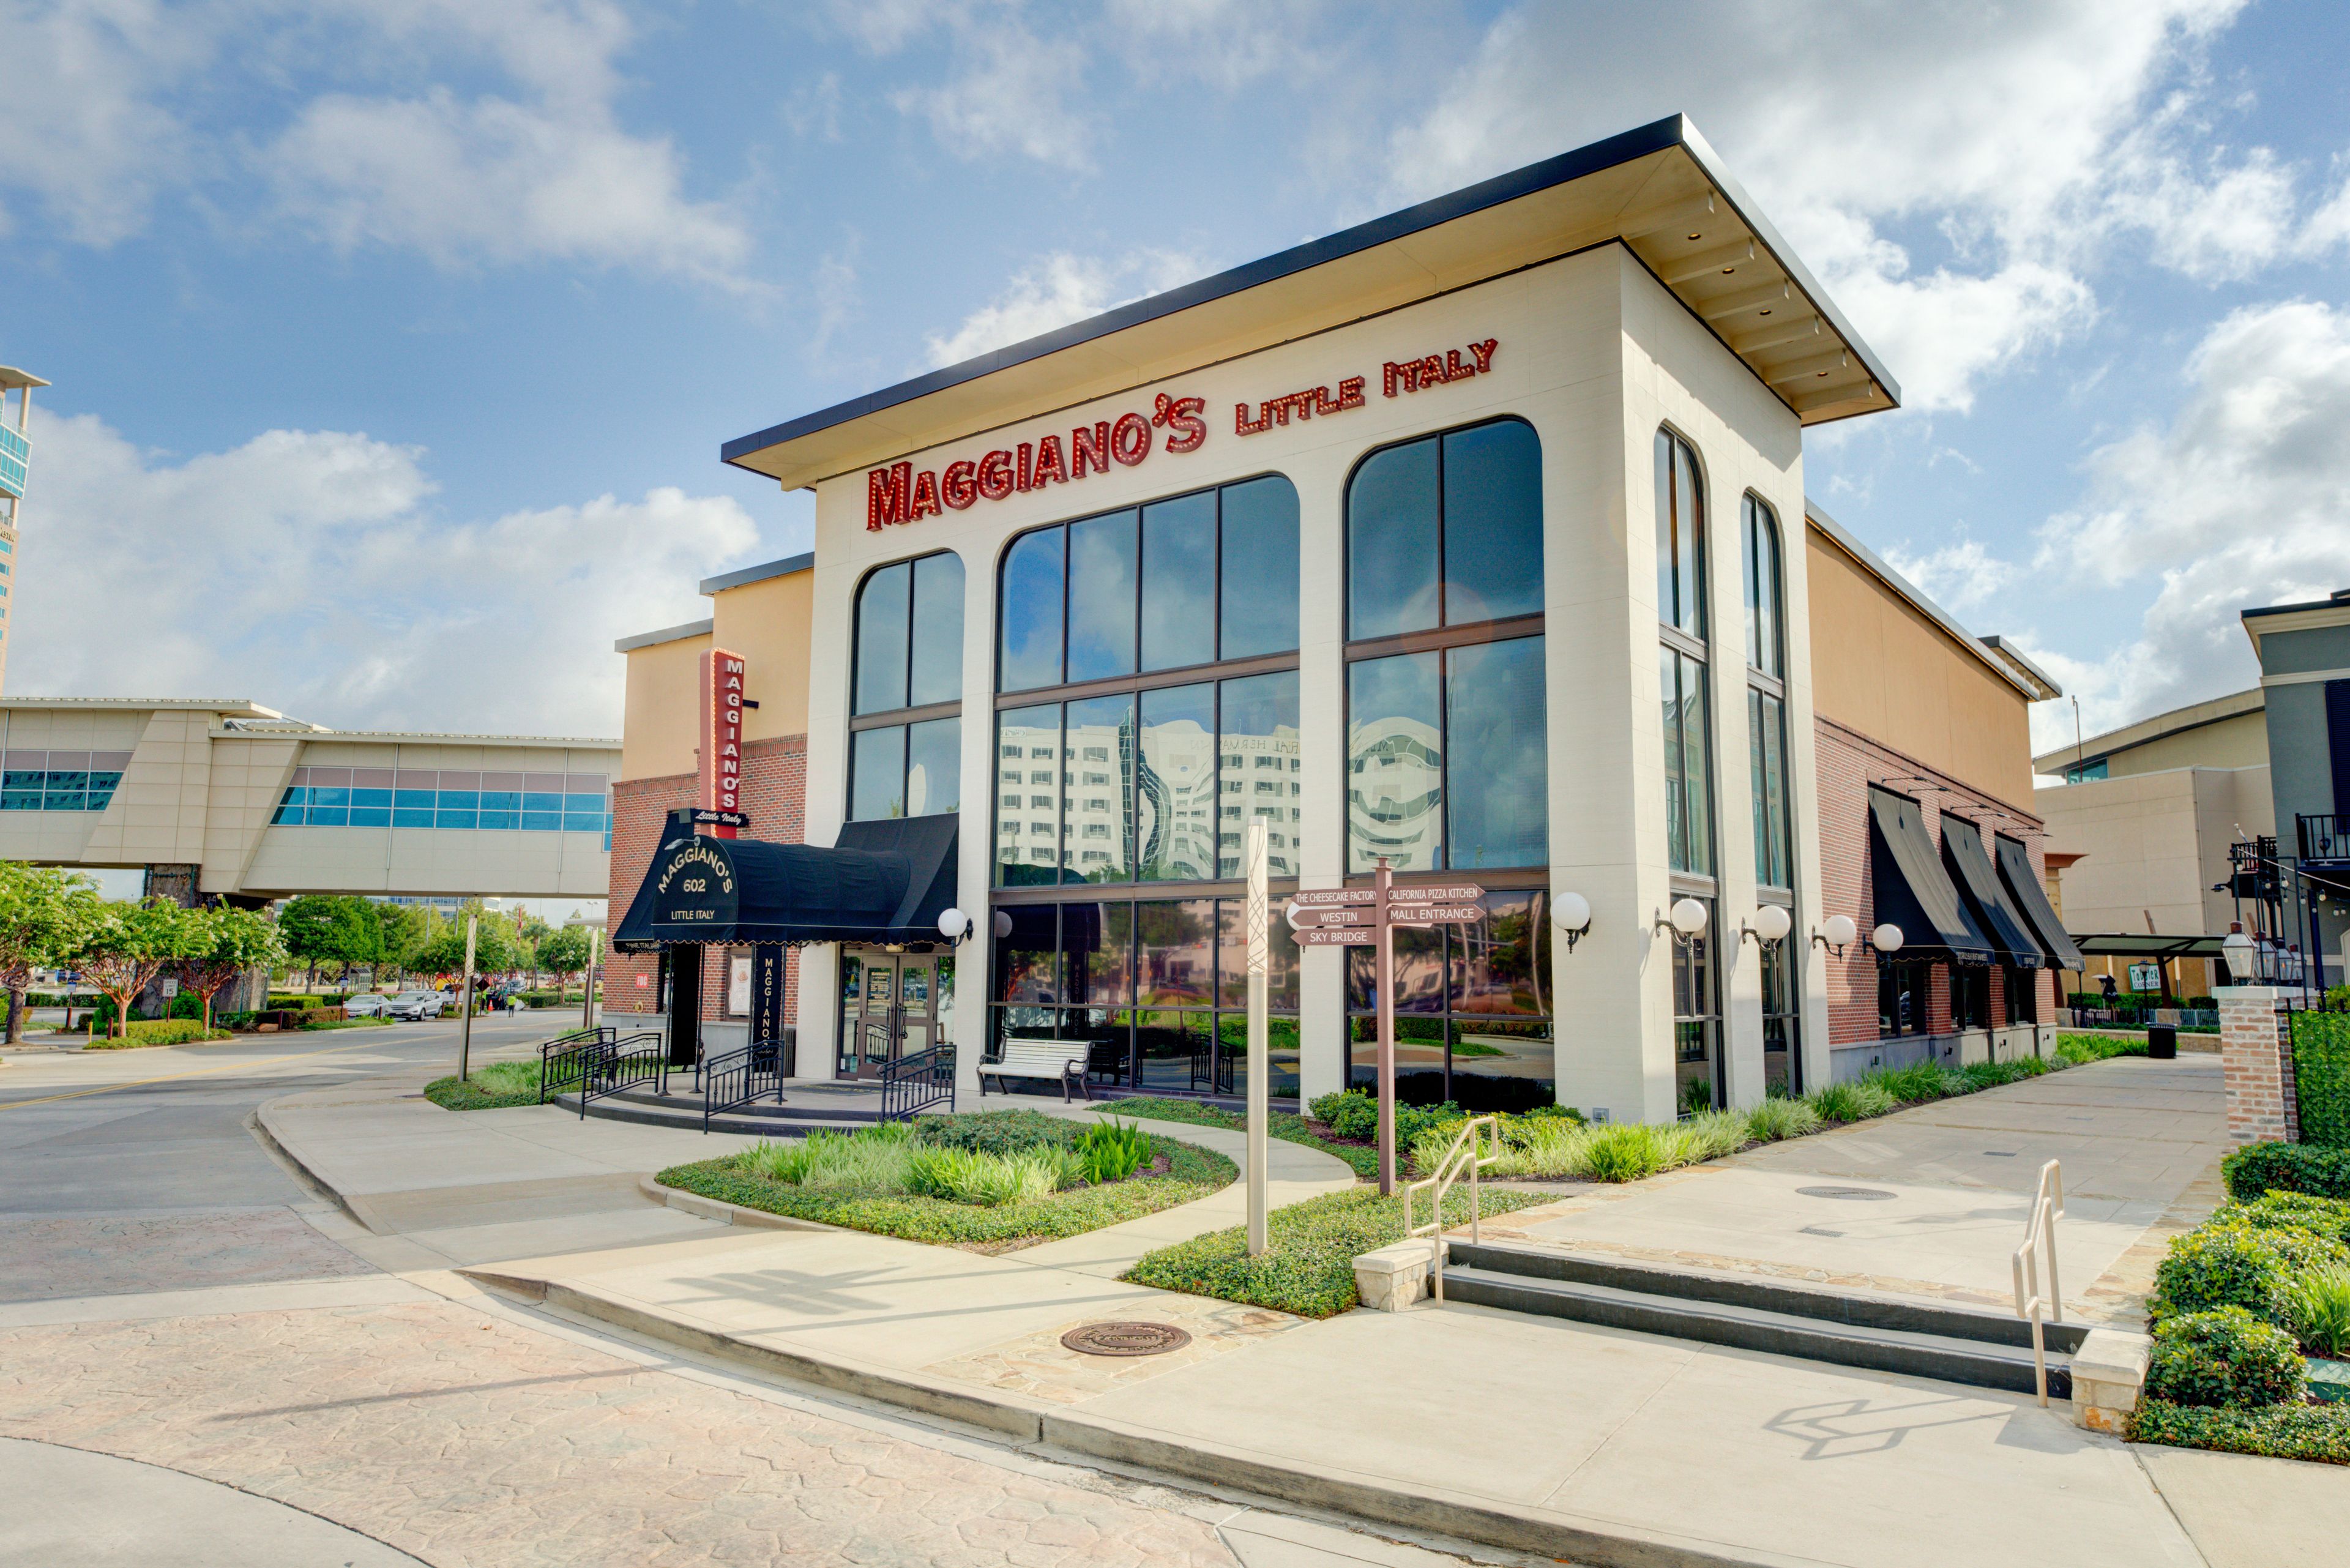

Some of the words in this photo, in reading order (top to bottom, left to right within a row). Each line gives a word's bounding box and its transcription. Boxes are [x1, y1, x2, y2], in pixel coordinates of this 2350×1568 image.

[866, 392, 1207, 532] MAGGIANO'S
[1235, 375, 1365, 436] LITTLE
[1382, 338, 1499, 398] ITALY
[722, 659, 743, 808] MAGGIANO'S
[695, 811, 719, 821] Little
[722, 813, 742, 825] Italy
[658, 846, 733, 894] MAGGIANO'S
[684, 879, 706, 892] 602
[1296, 894, 1308, 903] THE
[1310, 892, 1348, 903] CHEESECAKE
[1388, 889, 1426, 900] CALIFORNIA
[1428, 889, 1447, 899] PIZZA
[1449, 887, 1477, 898] KITCHEN
[671, 911, 694, 920] LITTLE
[696, 910, 715, 919] ITALY
[1320, 912, 1357, 922] WESTIN
[1390, 909, 1416, 920] MALL
[1419, 908, 1474, 919] ENTRANCE
[1310, 932, 1328, 942] SKY
[1331, 931, 1367, 942] BRIDGE
[637, 976, 647, 986] FDC
